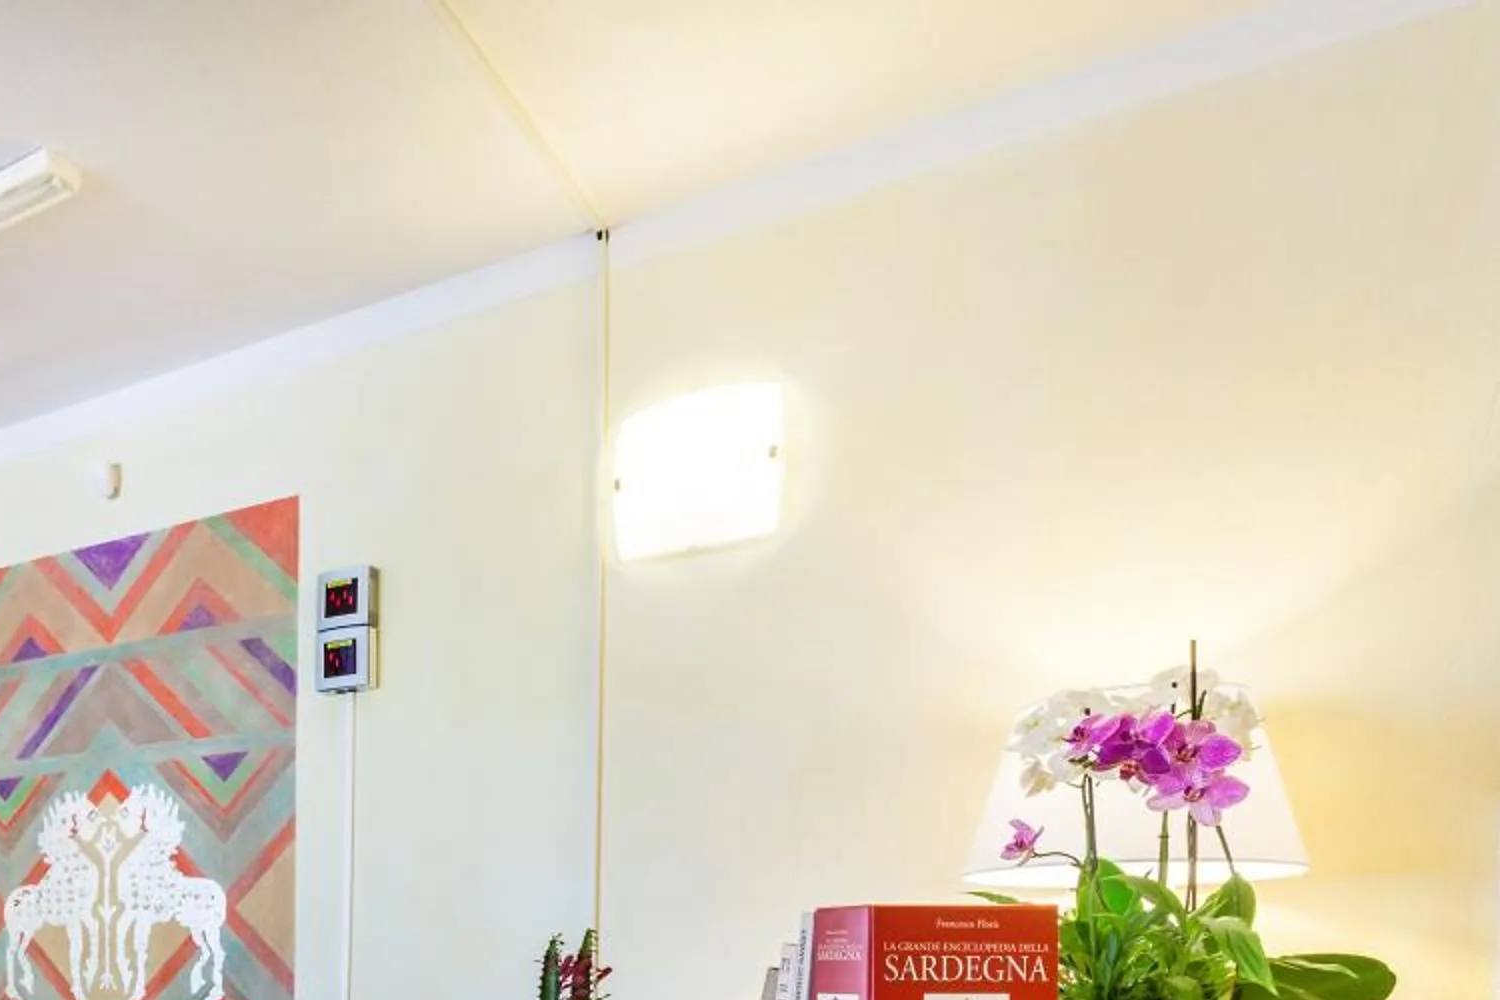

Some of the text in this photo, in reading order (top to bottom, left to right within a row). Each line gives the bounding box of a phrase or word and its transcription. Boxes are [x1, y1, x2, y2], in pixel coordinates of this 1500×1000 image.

[883, 942, 1049, 953] LA GRANDE ENCICLOPEDIA DELLA
[884, 954, 1049, 981] SARDEGNA
